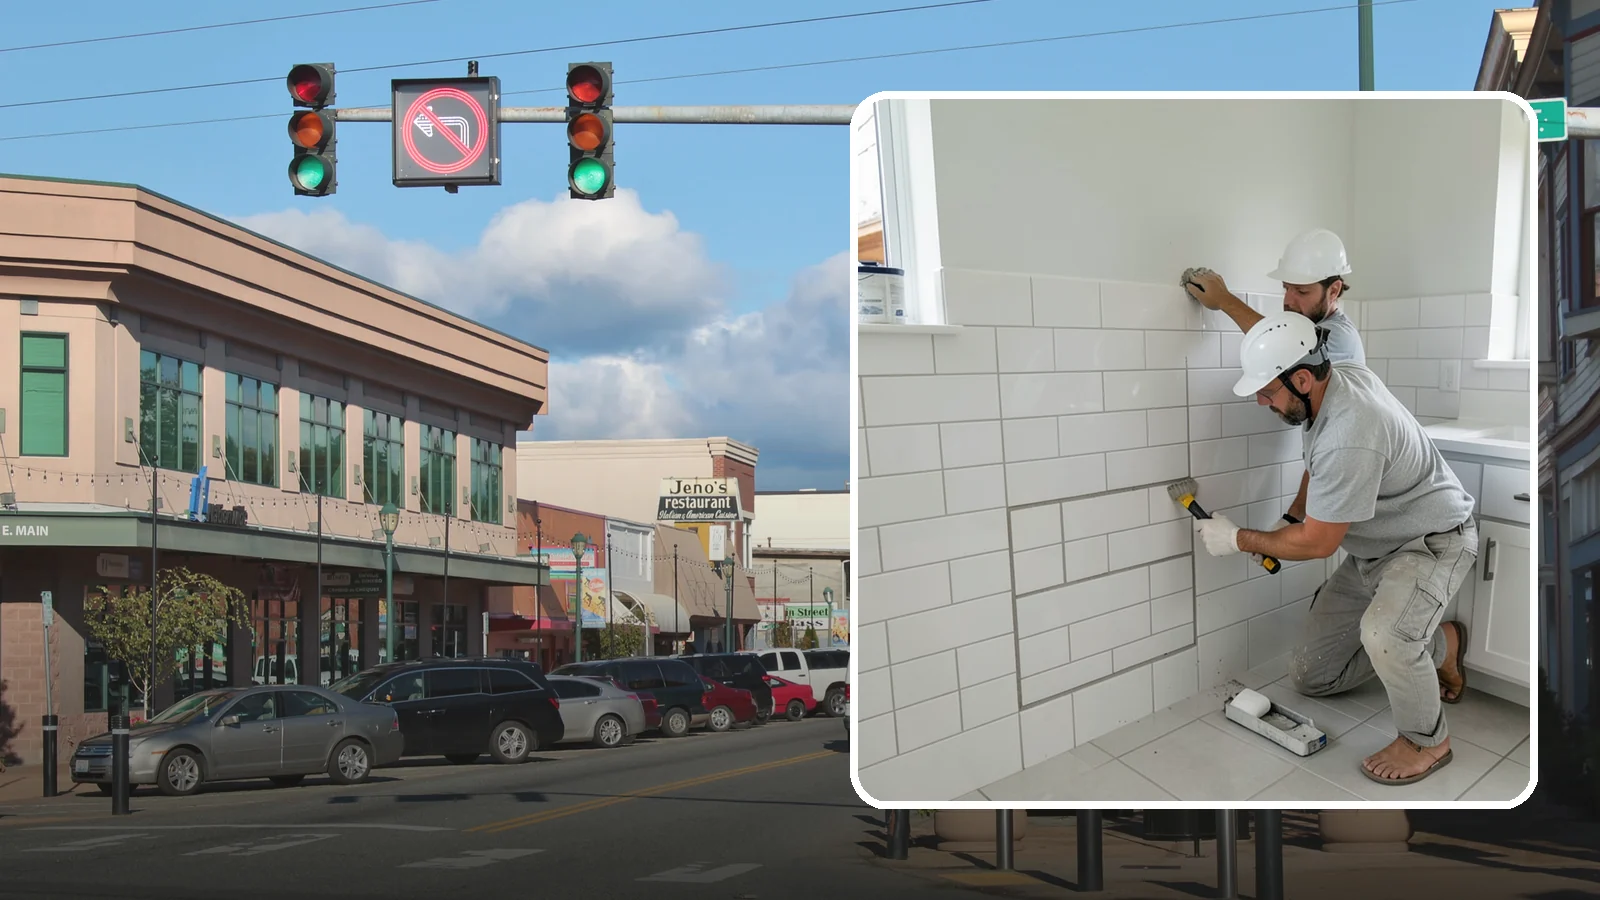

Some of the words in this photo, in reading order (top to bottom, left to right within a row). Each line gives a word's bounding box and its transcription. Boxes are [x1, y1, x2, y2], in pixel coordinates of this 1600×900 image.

[669, 480, 728, 494] Jeno's
[665, 496, 731, 509] restaurant
[659, 510, 681, 519] Italian
[686, 510, 715, 519] American
[715, 510, 738, 519] Cuisine
[15, 525, 49, 536] MAIN
[785, 607, 795, 617] in
[797, 607, 828, 617] Street
[791, 619, 824, 627] lass
